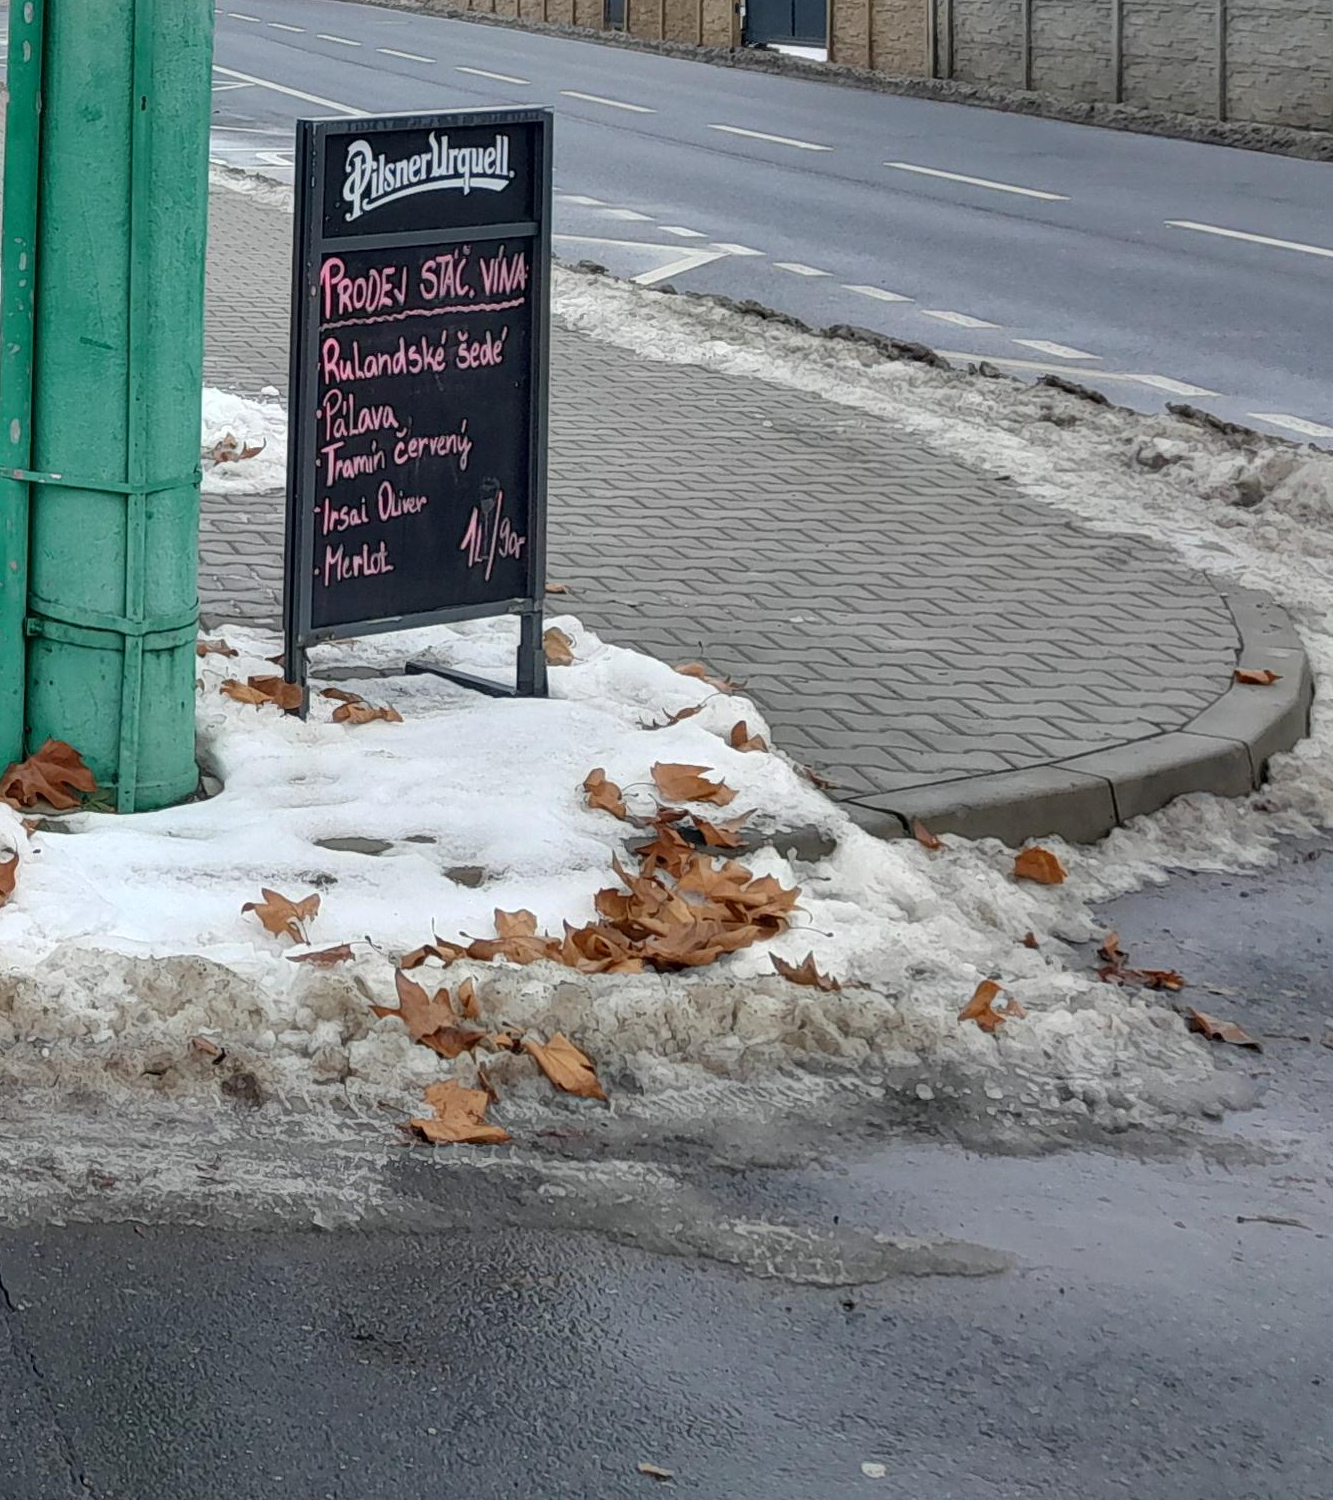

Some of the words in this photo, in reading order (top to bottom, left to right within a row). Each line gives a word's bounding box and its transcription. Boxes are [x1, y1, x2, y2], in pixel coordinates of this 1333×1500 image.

[343, 140, 432, 222] Pilsner
[320, 257, 407, 319] PRODEJ
[456, 326, 508, 369] šedé
